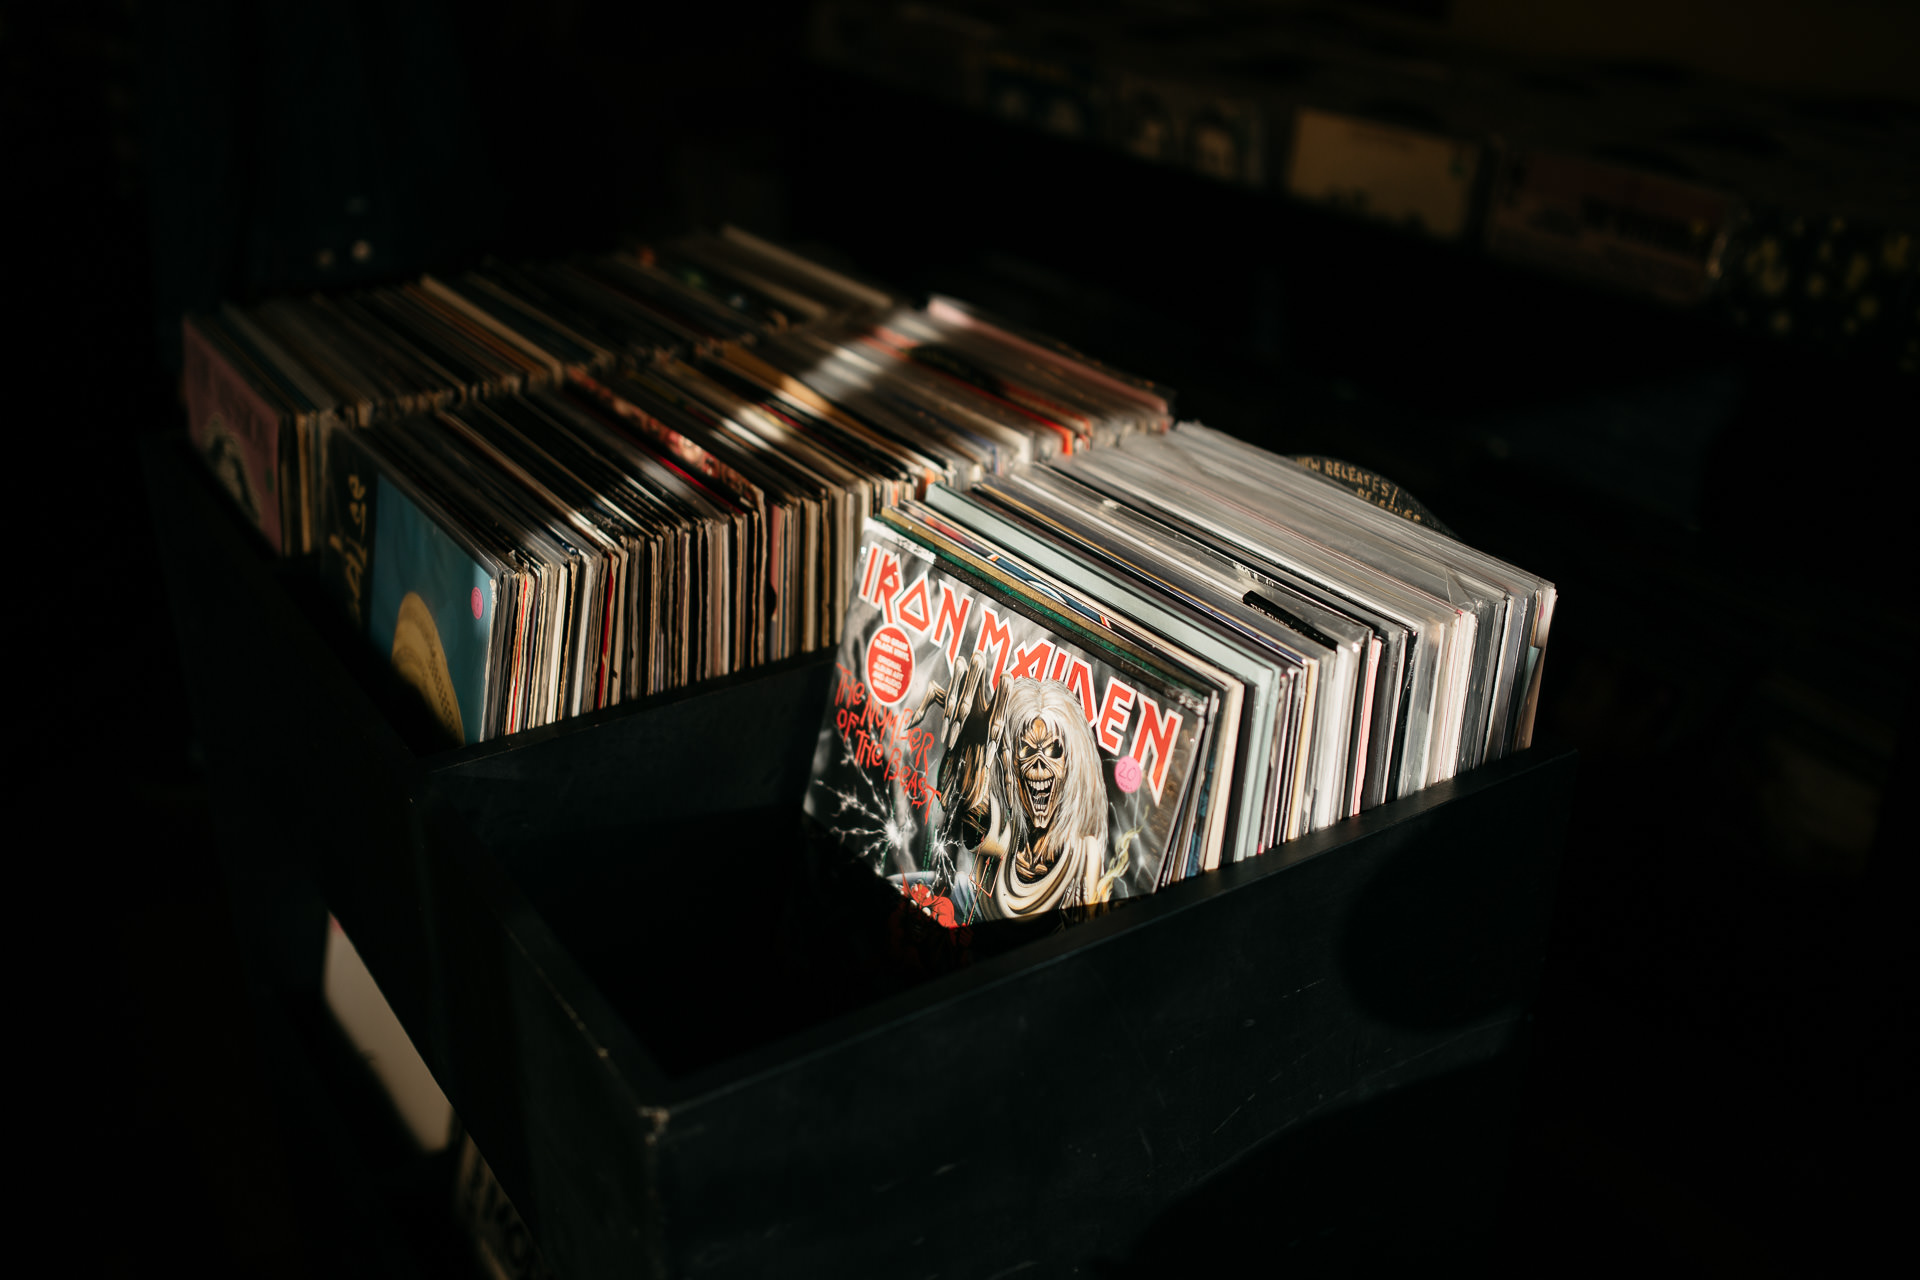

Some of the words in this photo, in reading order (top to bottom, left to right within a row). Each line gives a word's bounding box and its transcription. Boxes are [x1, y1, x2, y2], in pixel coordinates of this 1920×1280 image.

[836, 709, 859, 742] OF
[858, 541, 975, 679] IRON
[972, 603, 1184, 808] MAIDEN
